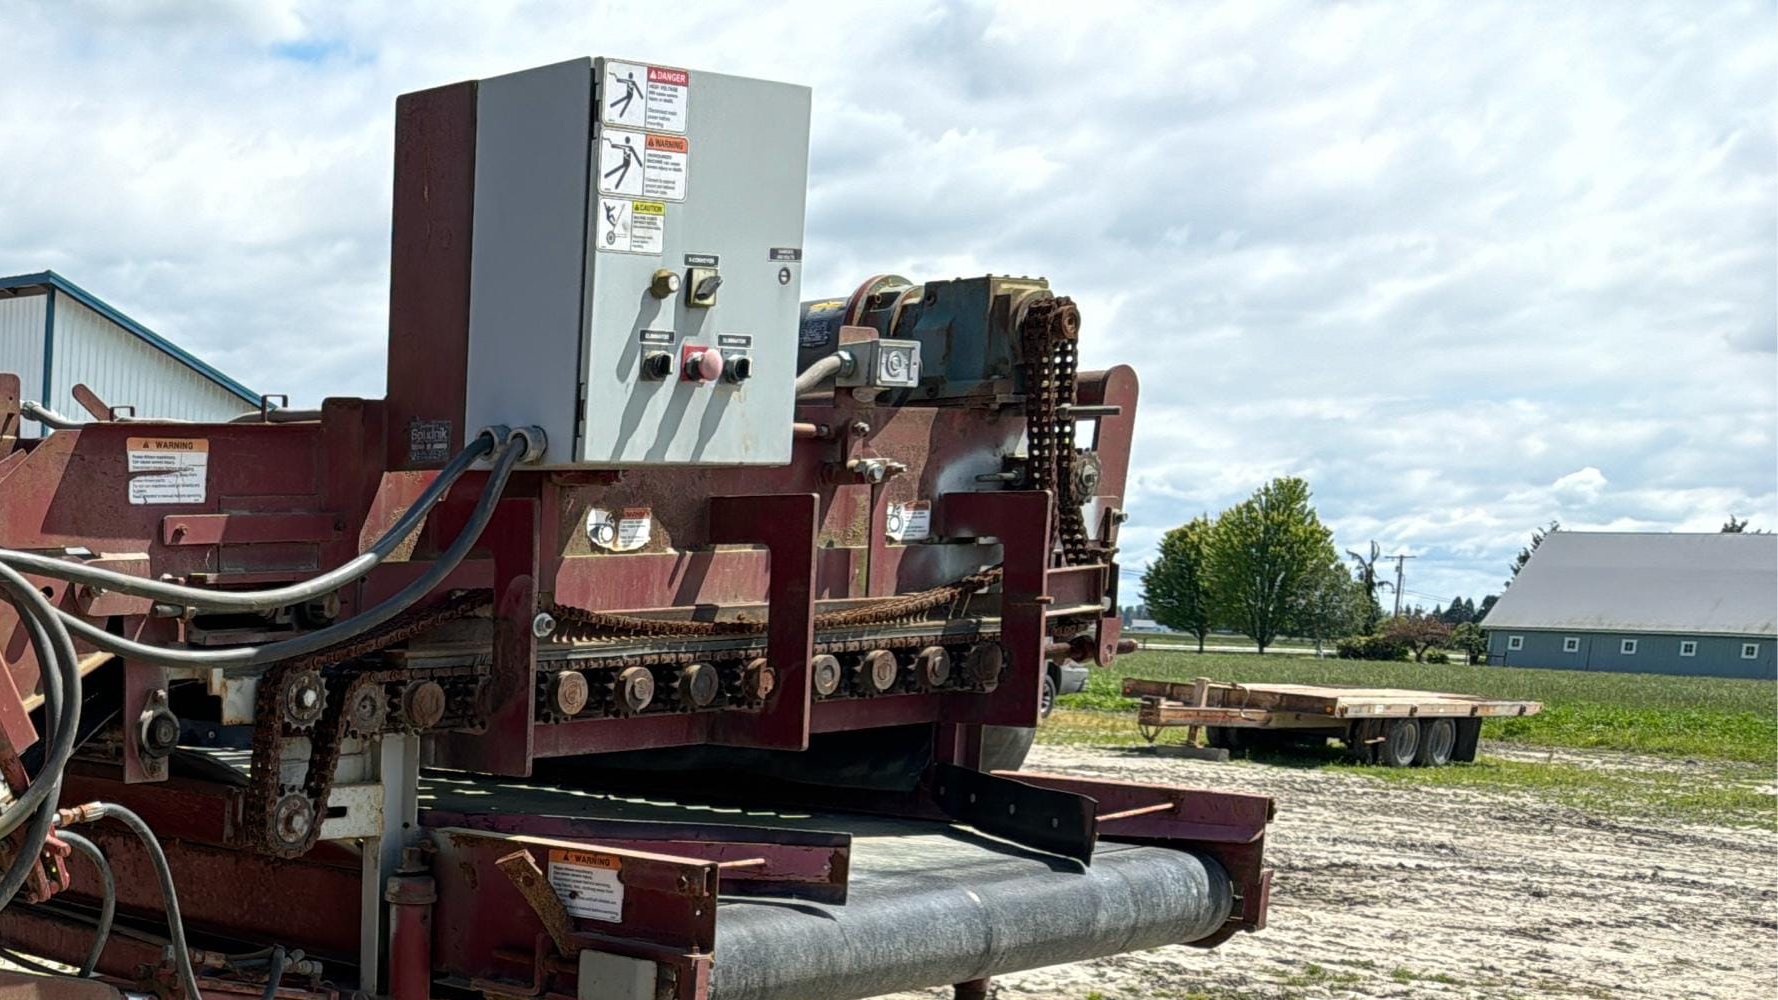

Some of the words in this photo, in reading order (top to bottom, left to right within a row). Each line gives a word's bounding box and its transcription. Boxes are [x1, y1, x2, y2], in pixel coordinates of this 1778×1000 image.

[657, 71, 686, 82] DANGER
[655, 140, 683, 150] WARNING
[640, 204, 662, 212] CAUTION
[575, 855, 610, 866] WARNING
